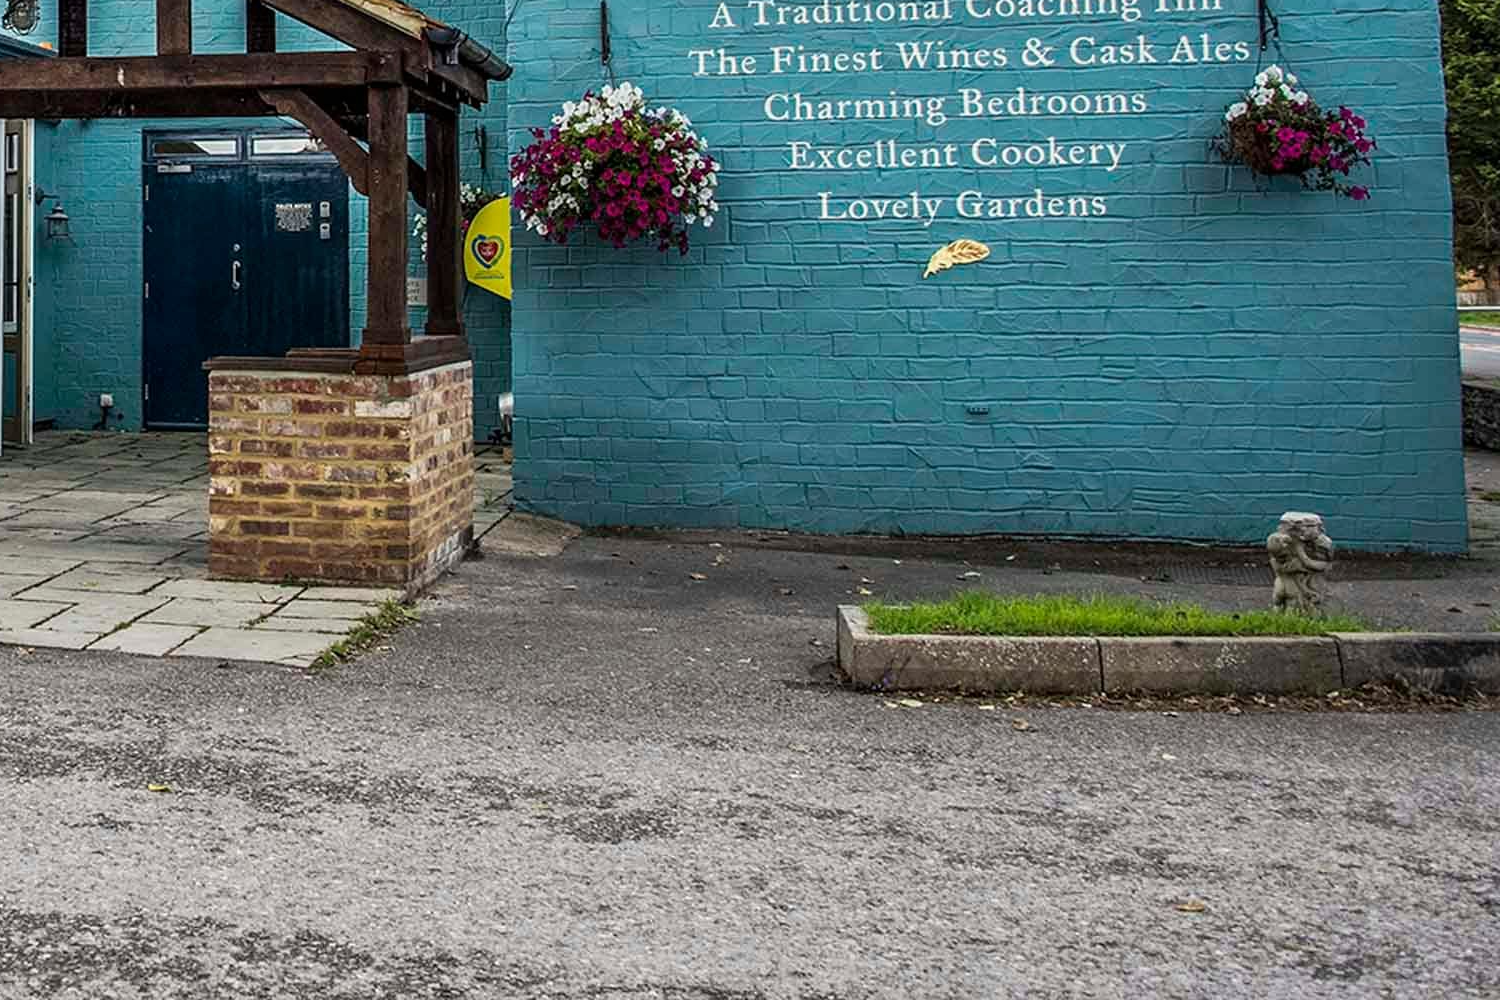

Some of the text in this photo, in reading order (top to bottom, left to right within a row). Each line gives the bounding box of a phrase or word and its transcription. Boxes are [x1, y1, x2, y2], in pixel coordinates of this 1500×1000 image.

[707, 1, 737, 29] A
[688, 33, 1250, 77] The Finest Wines & Cask Ales
[763, 87, 1148, 126] Charming Bedrooms
[787, 135, 1126, 172] Excellent Cookery
[817, 188, 1108, 227] Lovely Gardens
